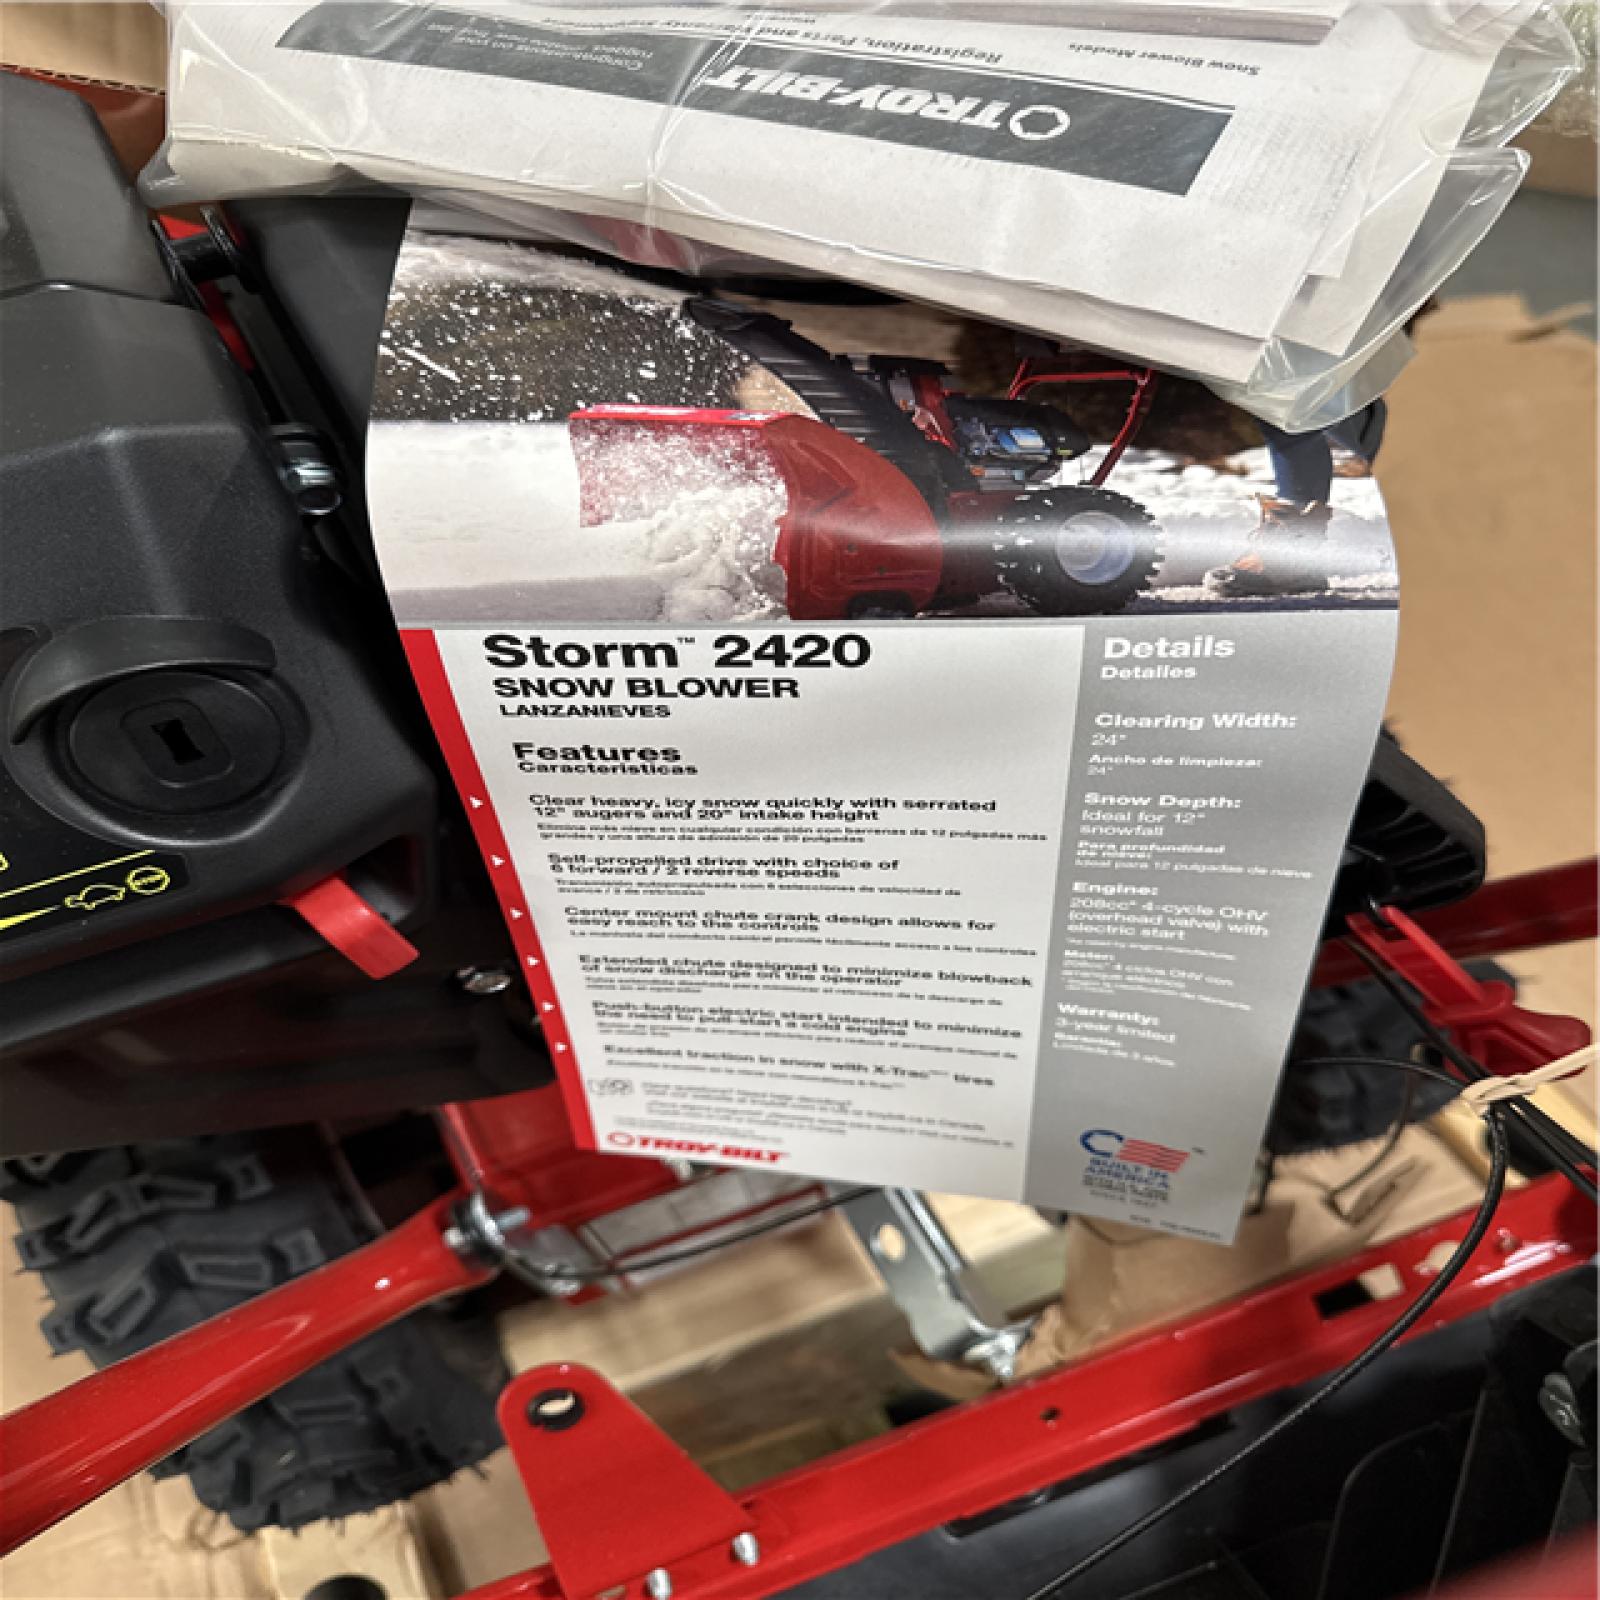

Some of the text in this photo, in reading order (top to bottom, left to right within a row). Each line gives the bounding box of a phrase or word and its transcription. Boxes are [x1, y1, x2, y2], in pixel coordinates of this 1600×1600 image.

[800, 30, 858, 47] Parts
[865, 36, 1004, 64] Registration,
[1068, 42, 1261, 76] Snow Blower Models
[700, 64, 1011, 130] TROY-BILT
[713, 634, 870, 668] 2420
[1103, 634, 1236, 660] Details
[1100, 664, 1198, 680] Detalles
[493, 677, 800, 699] SNOW BLOWER
[500, 704, 671, 719] LANZANIEVES
[1094, 711, 1299, 731] Clearing Width:
[1090, 732, 1128, 747] 24"
[512, 741, 682, 762] Features
[1088, 754, 1265, 769] Ancho de limpieza:
[528, 793, 997, 811] Clear heavy, icy snow quickly with serrated
[1083, 791, 1242, 810] Snow Depth:
[533, 806, 880, 821] 12" augers and 20" intake height
[1081, 809, 1207, 826] Ideal for 12"
[1079, 824, 1165, 837] snowfall
[547, 853, 692, 868] Self-propelled
[695, 856, 748, 868] drive
[753, 857, 797, 869] with
[802, 857, 872, 871] choice
[568, 863, 648, 876] forward
[685, 866, 760, 878] reverse
[765, 867, 840, 880] speeds
[1071, 881, 1159, 897] Engine:
[565, 905, 995, 931] Center mount chute crank design allows for
[1141, 901, 1215, 917] 4-cycle
[1219, 905, 1270, 922] OHV
[567, 917, 612, 928] easy
[617, 918, 673, 929] reach
[700, 920, 733, 930] the
[737, 921, 820, 933] controls
[1066, 923, 1186, 941] electric start
[1068, 909, 1270, 938] (overhead valve) with
[580, 953, 667, 968] Extended
[672, 956, 724, 971] chute
[730, 959, 817, 976] designed
[847, 965, 933, 981] minimize
[938, 970, 1032, 987] blowback
[1057, 1001, 1161, 1027] Warranty:
[937, 1021, 1022, 1039] minimize
